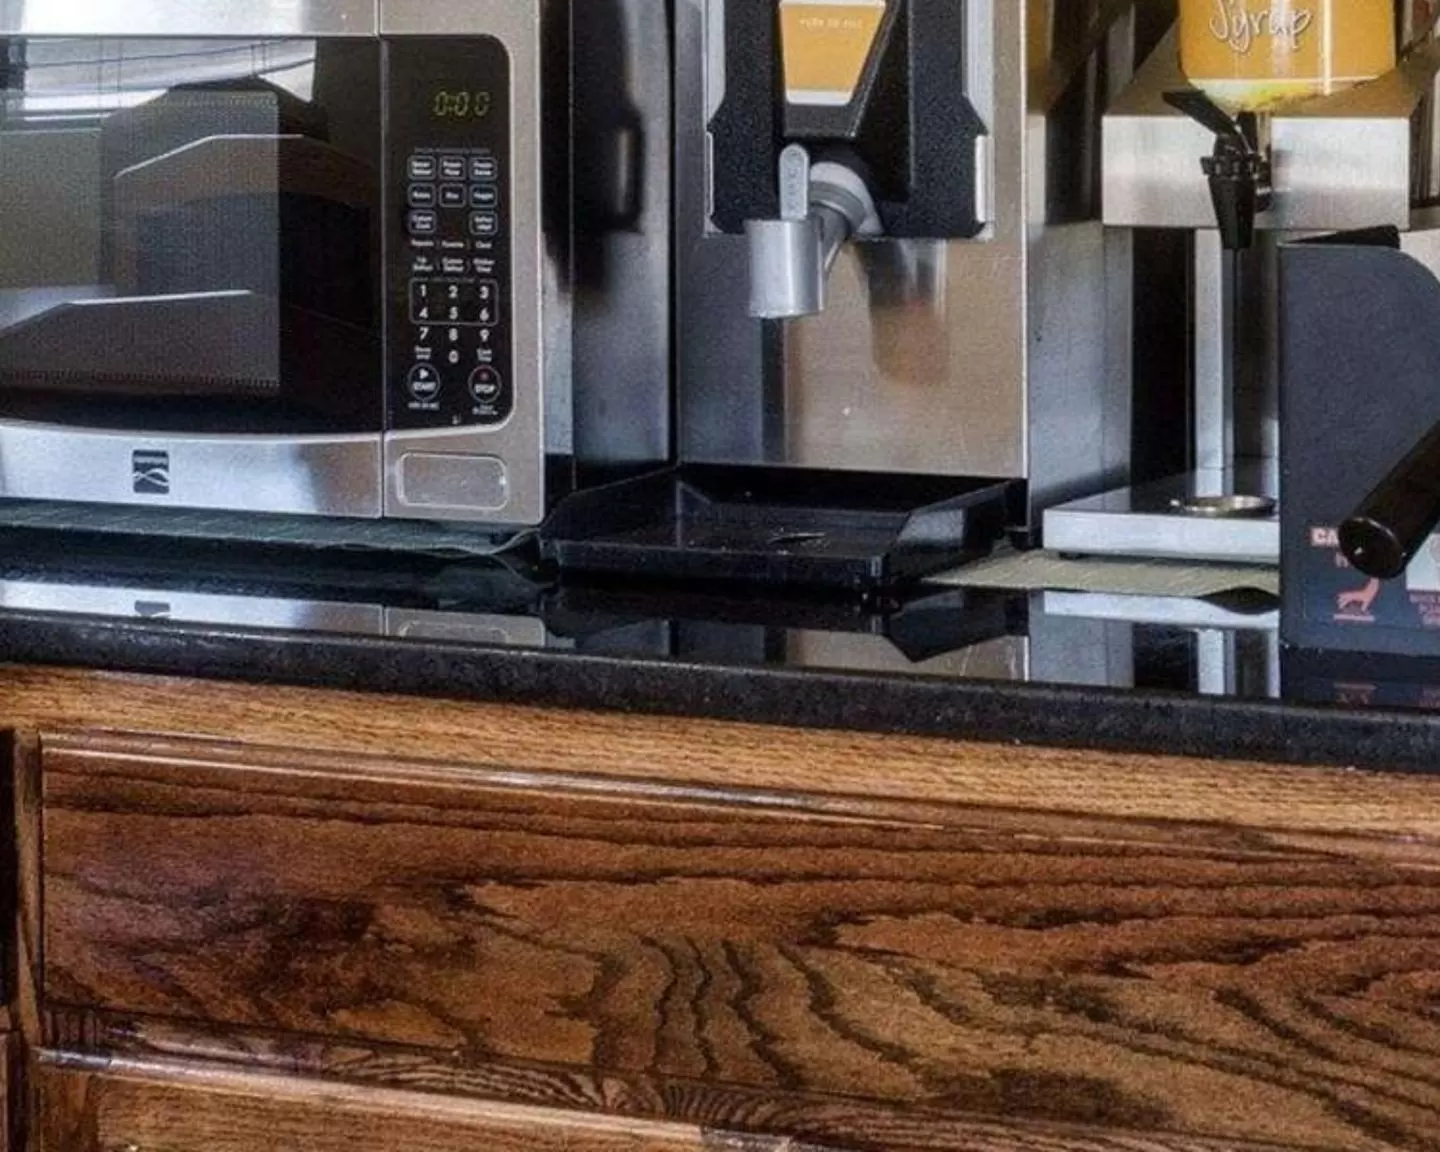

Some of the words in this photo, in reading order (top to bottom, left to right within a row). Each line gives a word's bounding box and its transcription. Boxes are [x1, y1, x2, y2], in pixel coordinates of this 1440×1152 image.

[448, 285, 459, 299] 2
[479, 285, 490, 300] 3
[418, 306, 429, 320] 4
[449, 306, 459, 320] 5
[479, 307, 490, 322] 6
[419, 326, 430, 341] 7
[448, 327, 459, 342] 8
[479, 328, 490, 343] 9
[448, 349, 460, 364] 0
